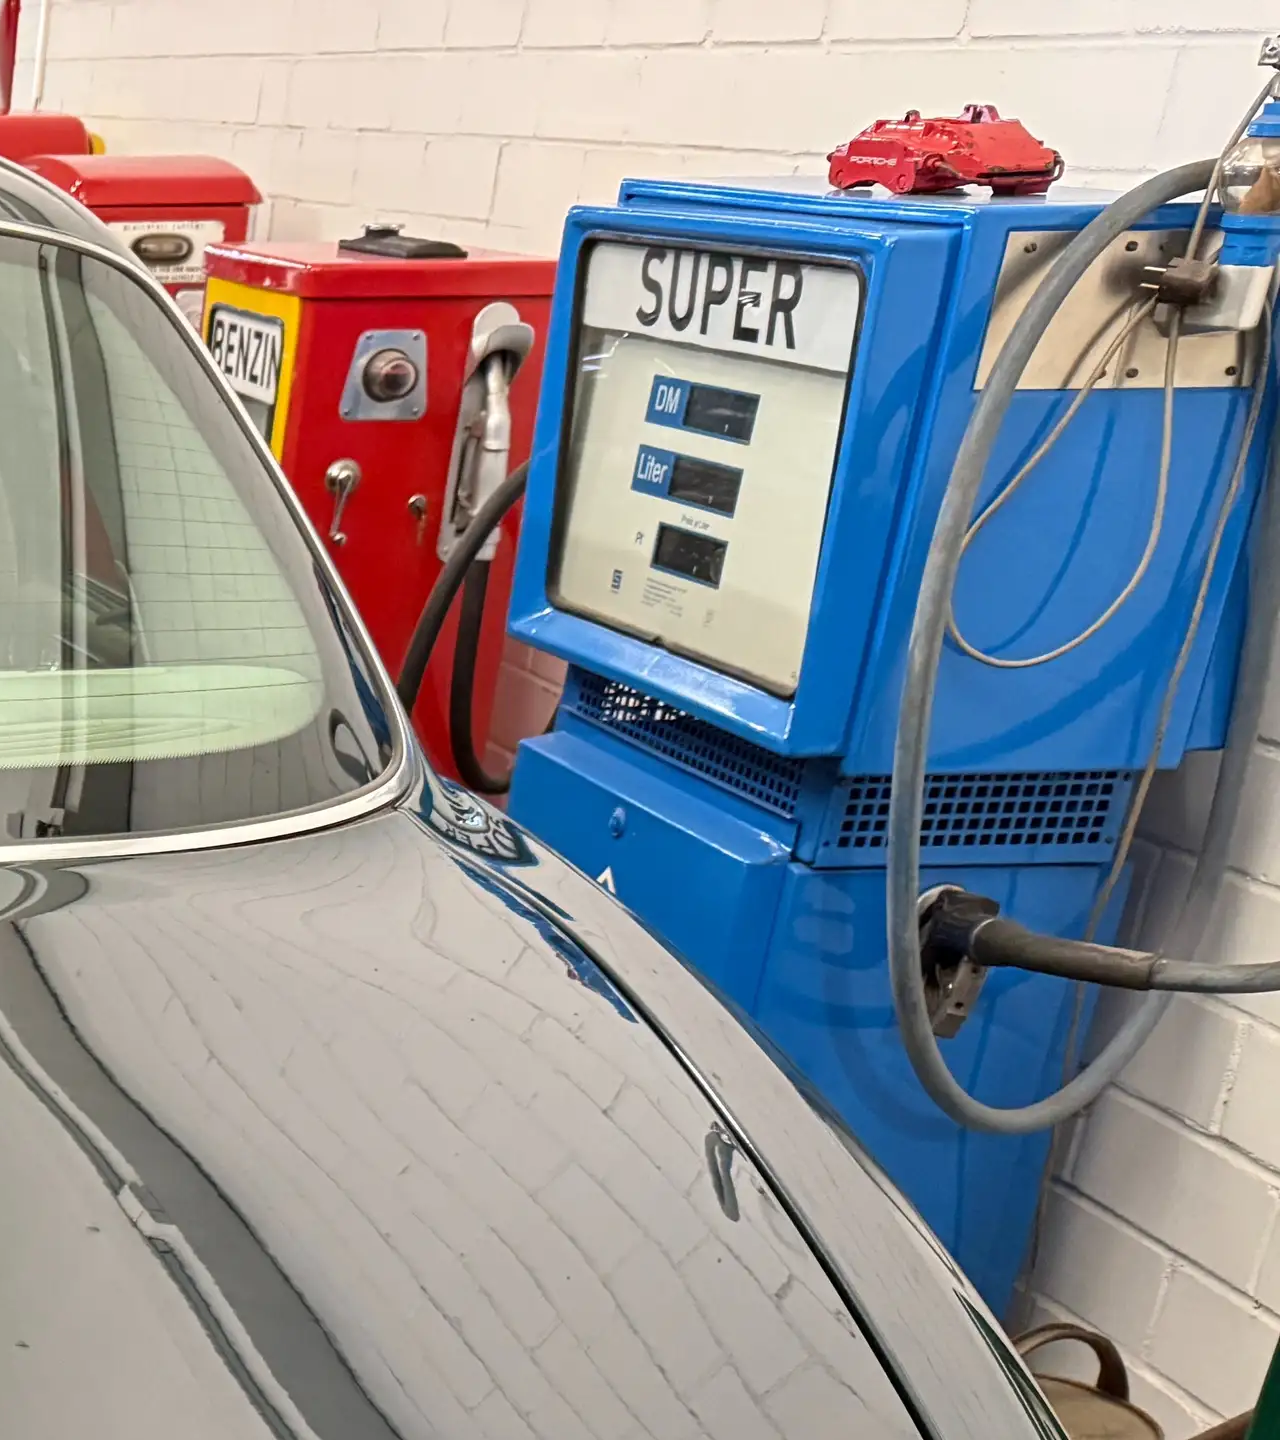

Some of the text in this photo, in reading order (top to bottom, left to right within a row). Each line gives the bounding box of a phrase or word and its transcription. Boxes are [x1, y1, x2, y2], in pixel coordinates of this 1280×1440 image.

[636, 247, 804, 350] SUPER
[211, 319, 279, 389] BENZIN
[655, 384, 682, 414] DM
[636, 452, 668, 484] Liter
